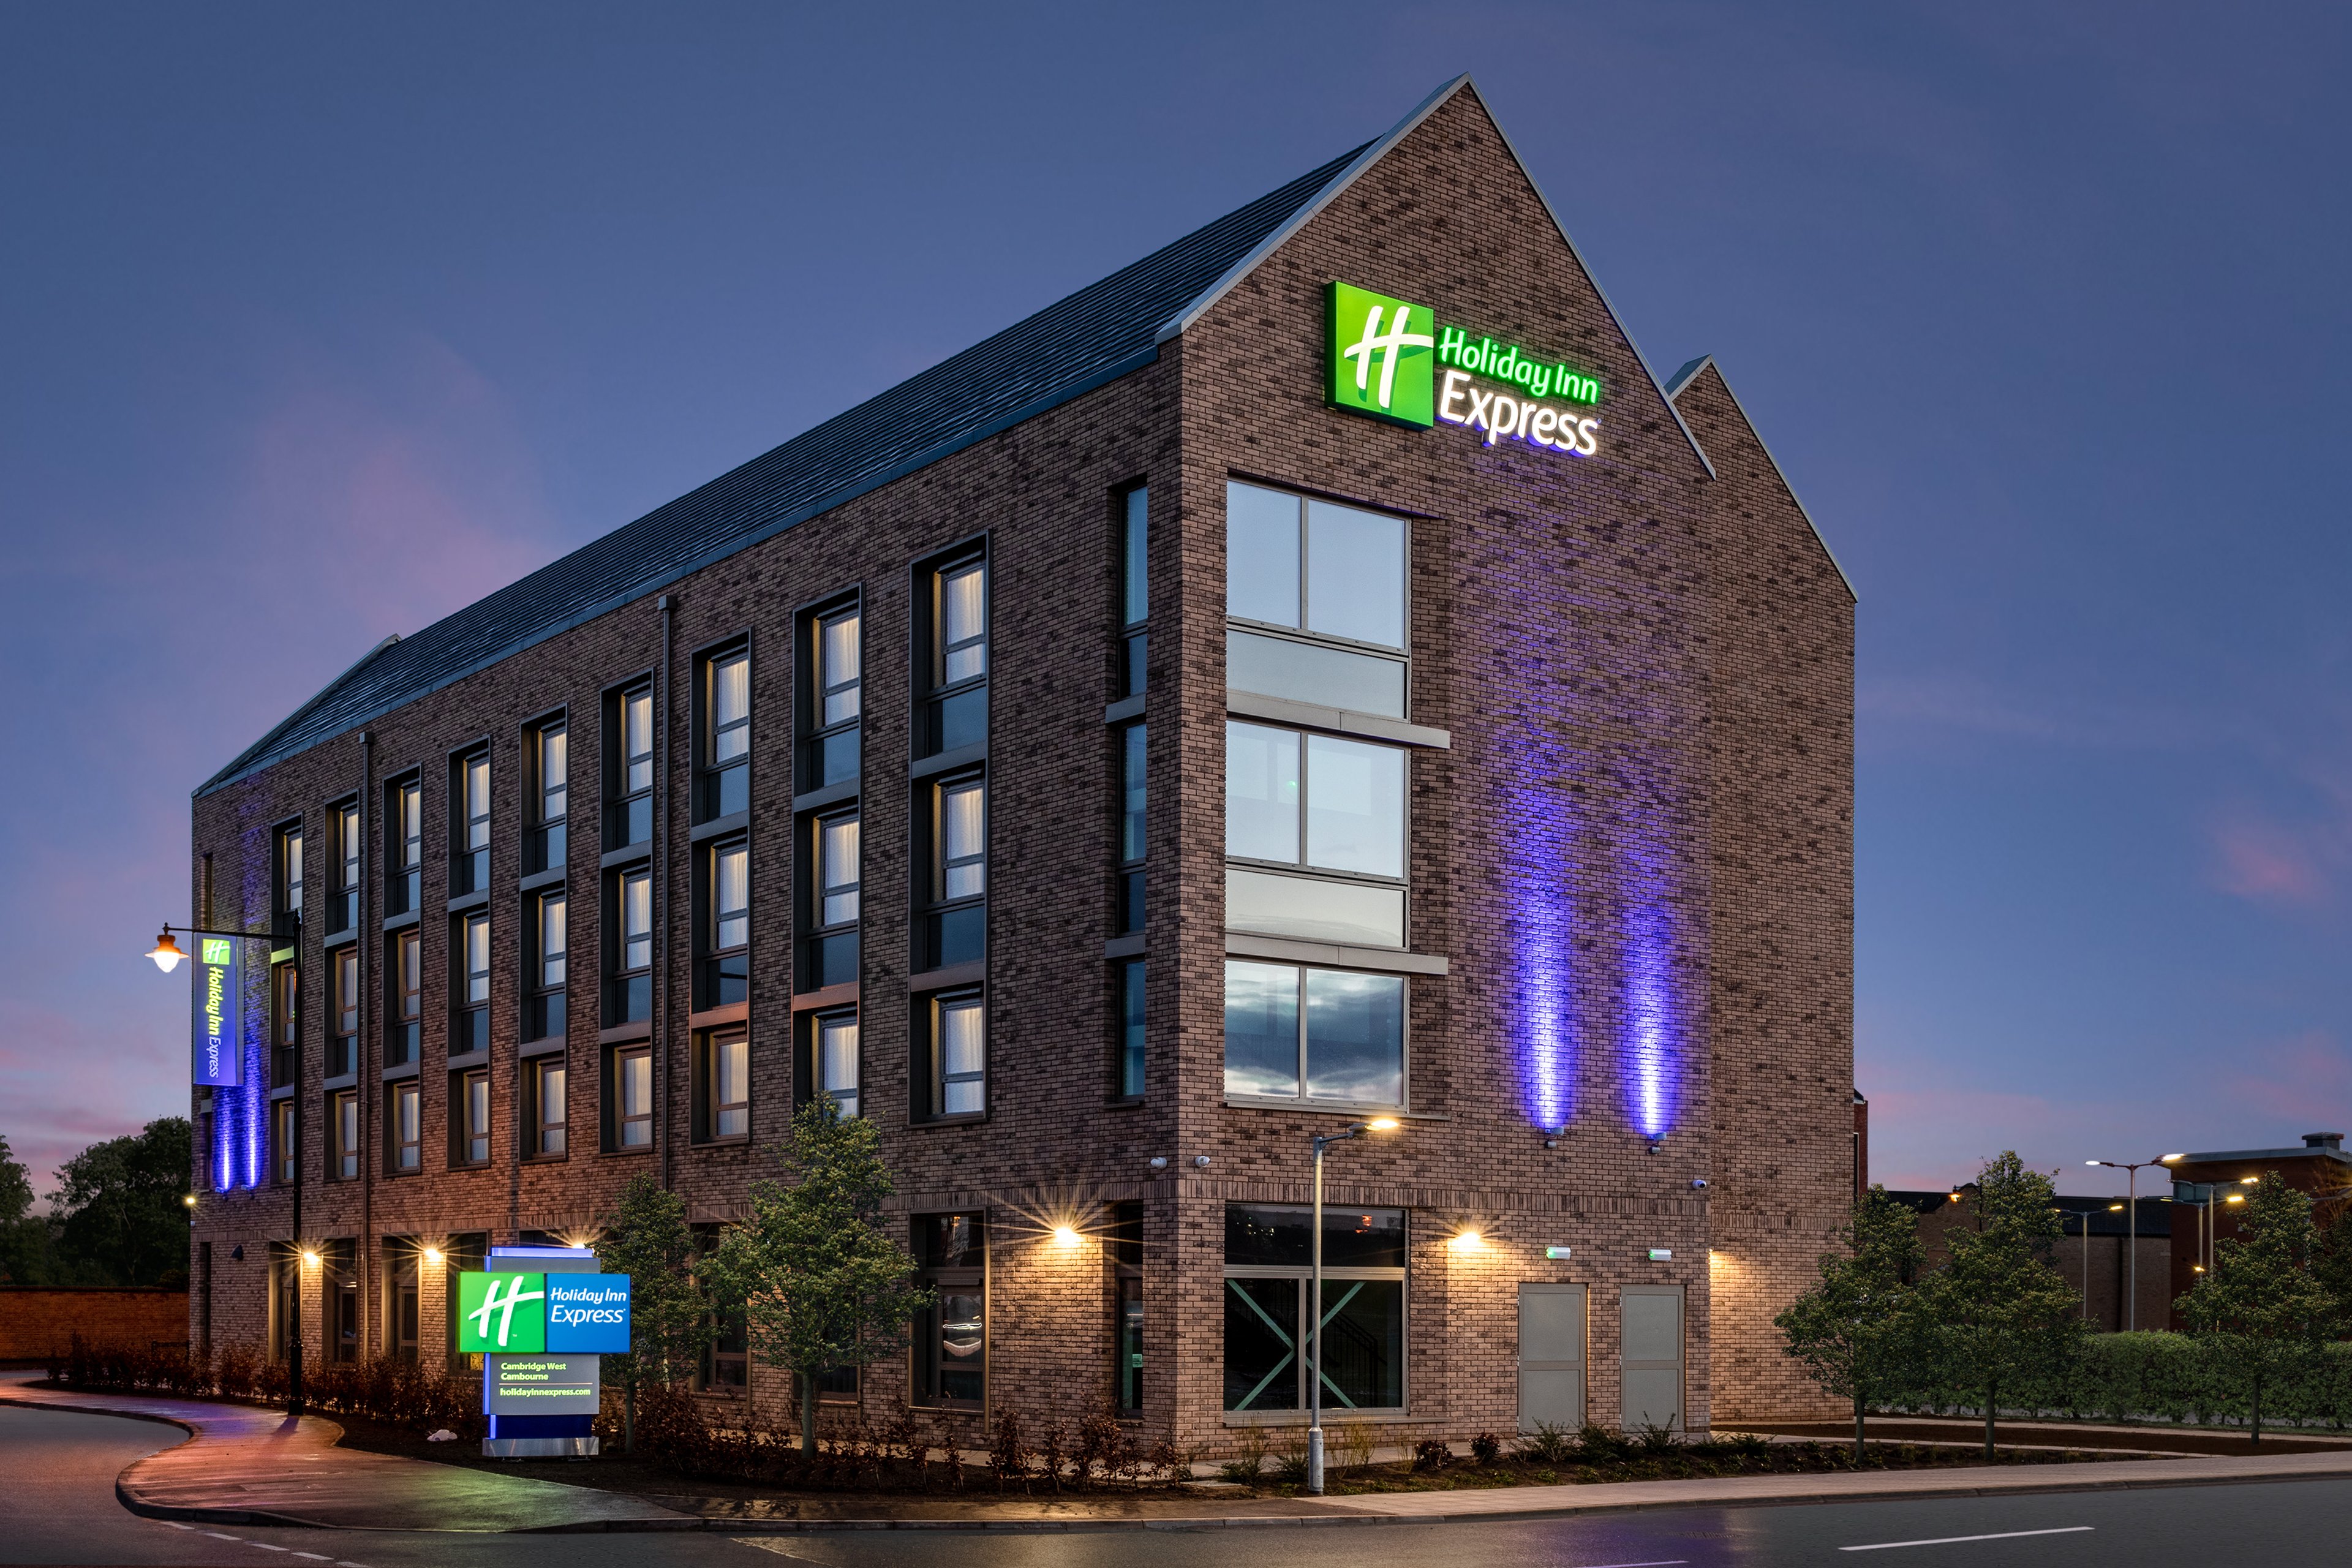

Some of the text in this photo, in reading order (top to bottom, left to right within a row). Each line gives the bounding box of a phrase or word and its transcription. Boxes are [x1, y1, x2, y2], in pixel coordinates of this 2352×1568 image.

[1439, 326, 1599, 404] Holiday Inn
[1439, 370, 1599, 456] Express
[206, 967, 224, 1078] Holiday Inn Express
[550, 1287, 627, 1305] Holiday Inn
[550, 1305, 624, 1327] Express
[500, 1362, 546, 1371] Cambridge
[500, 1388, 590, 1397] holidayinnexpress.com
